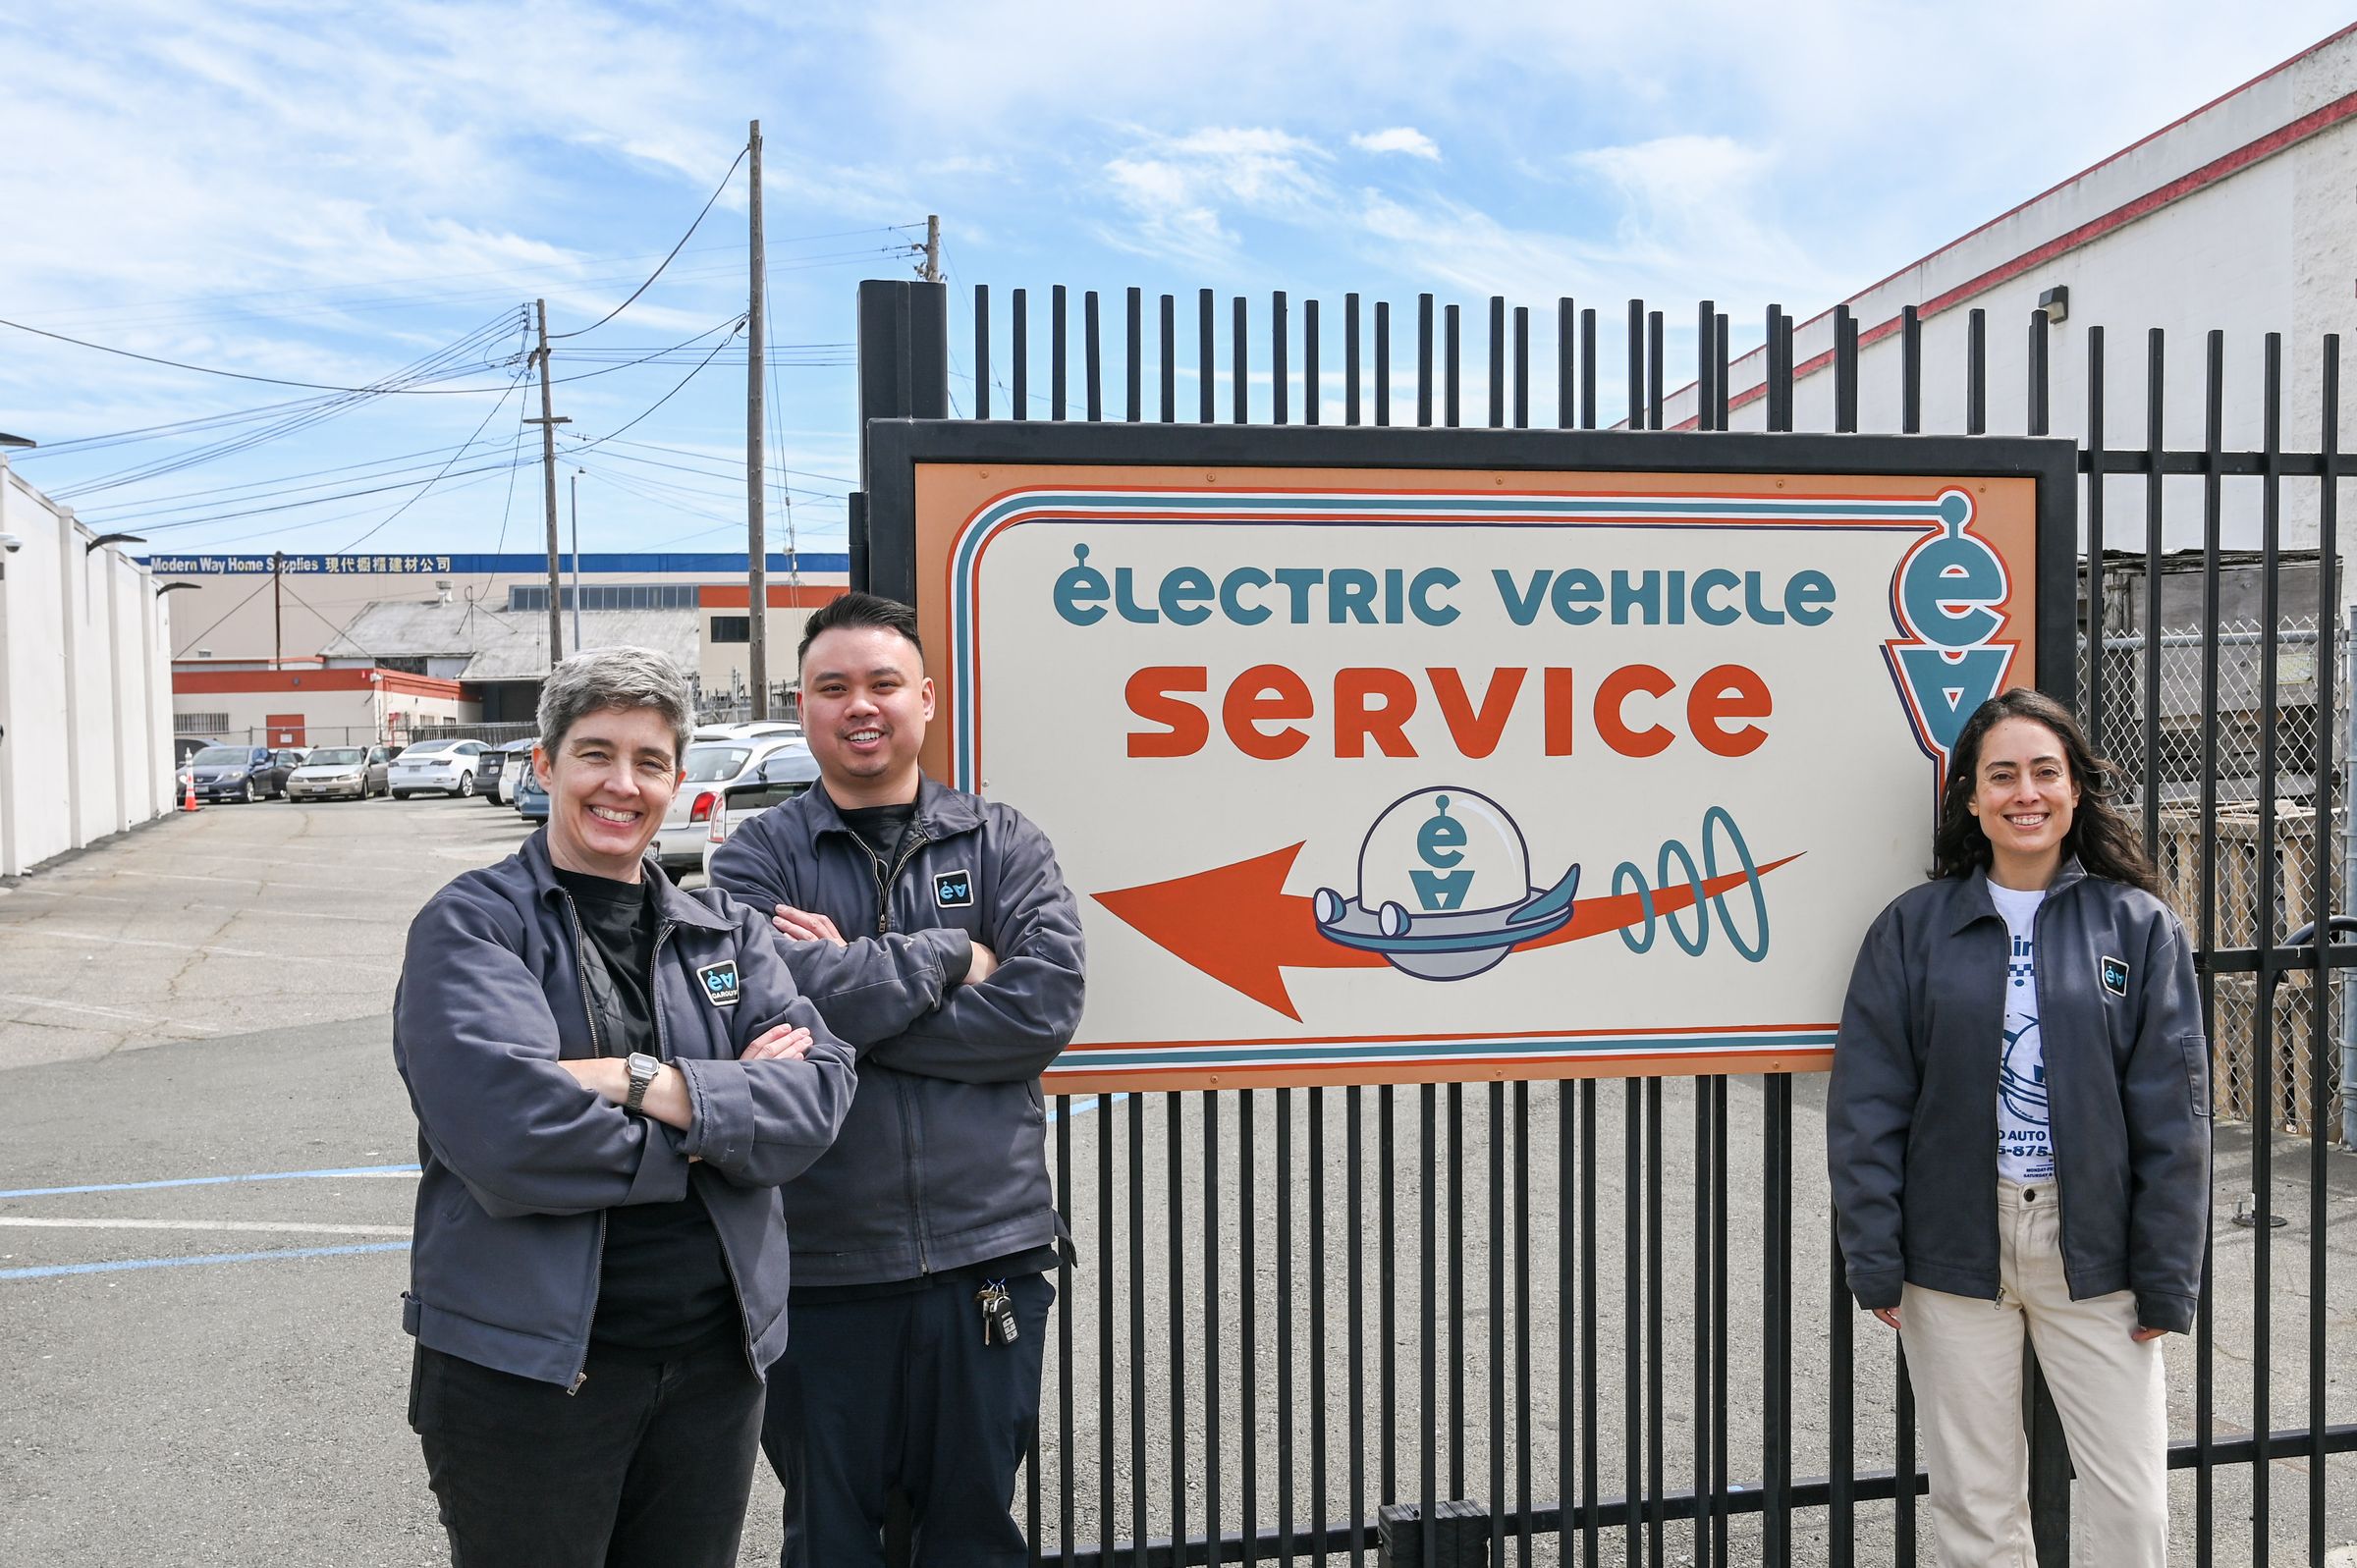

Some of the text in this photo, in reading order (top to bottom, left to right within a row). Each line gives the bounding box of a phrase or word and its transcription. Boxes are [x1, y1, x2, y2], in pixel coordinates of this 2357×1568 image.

[150, 557, 197, 571] Modern
[199, 557, 225, 574] Way
[227, 557, 263, 571] Home
[2007, 1130, 2047, 1142] AUTO
